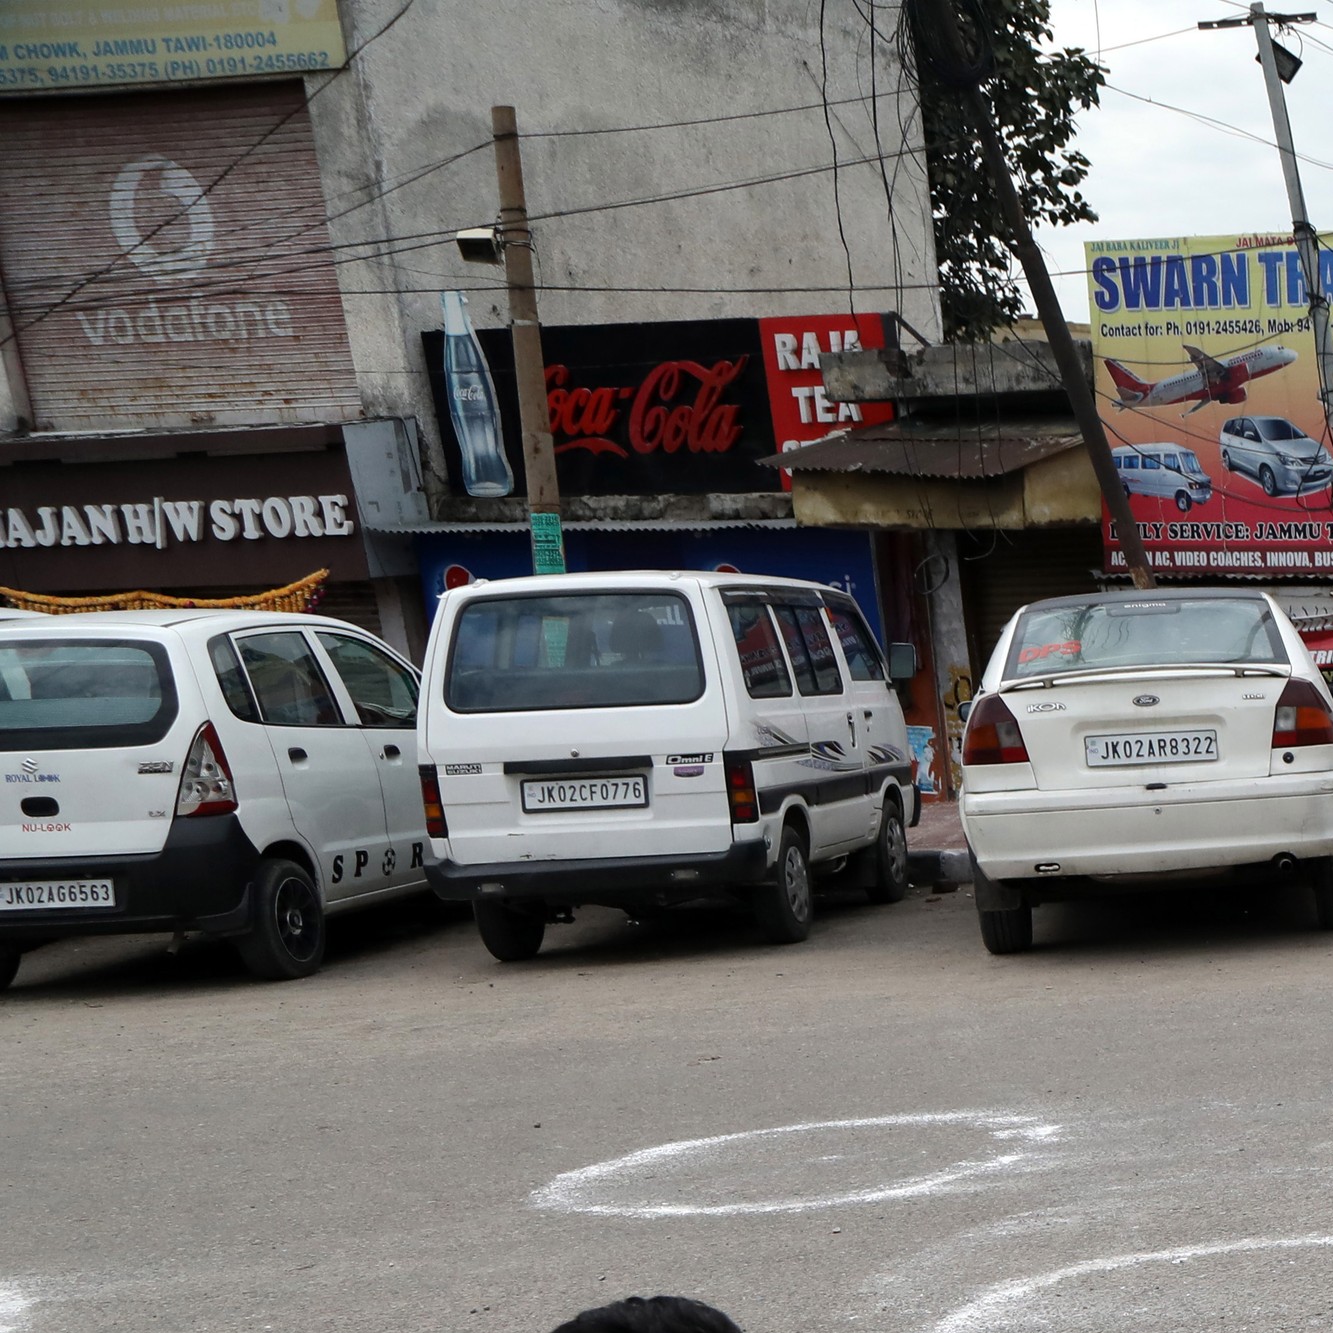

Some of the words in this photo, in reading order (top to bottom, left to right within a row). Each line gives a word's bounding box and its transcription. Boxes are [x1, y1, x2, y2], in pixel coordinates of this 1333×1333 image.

[14, 42, 87, 60] CHOWK,
[92, 36, 157, 57] JAMMU
[161, 31, 277, 54] TAWI-180004
[50, 60, 160, 82] 94191-35375
[165, 60, 200, 82] (PH)
[206, 51, 330, 75] 0191-2455662
[1256, 236, 1284, 247] MATA
[1094, 251, 1251, 314] SWARN
[76, 293, 293, 345] vodafone
[1100, 322, 1142, 338] Contact
[1144, 320, 1162, 335] for:
[1166, 320, 1182, 336] Ph.
[1186, 318, 1264, 336] 0191-2455426,
[1268, 318, 1293, 334] Mob:
[210, 494, 354, 542] STORE
[1168, 522, 1250, 541] SERVICE:
[1254, 522, 1320, 541] JAMMU
[1155, 551, 1173, 568] AC,
[1174, 551, 1208, 567] VIDEO
[1210, 550, 1265, 568] COACHES,
[1266, 552, 1312, 568] INNOVA,
[1124, 602, 1166, 610] enigma
[1018, 640, 1082, 664] DPS
[668, 754, 702, 764] Omni
[1101, 736, 1215, 760] JK02AR8322
[138, 760, 174, 774] ZEN
[5, 774, 32, 784] ROYAL
[537, 777, 642, 804] JK02CF0776
[6, 884, 110, 906] JK02AG6563
